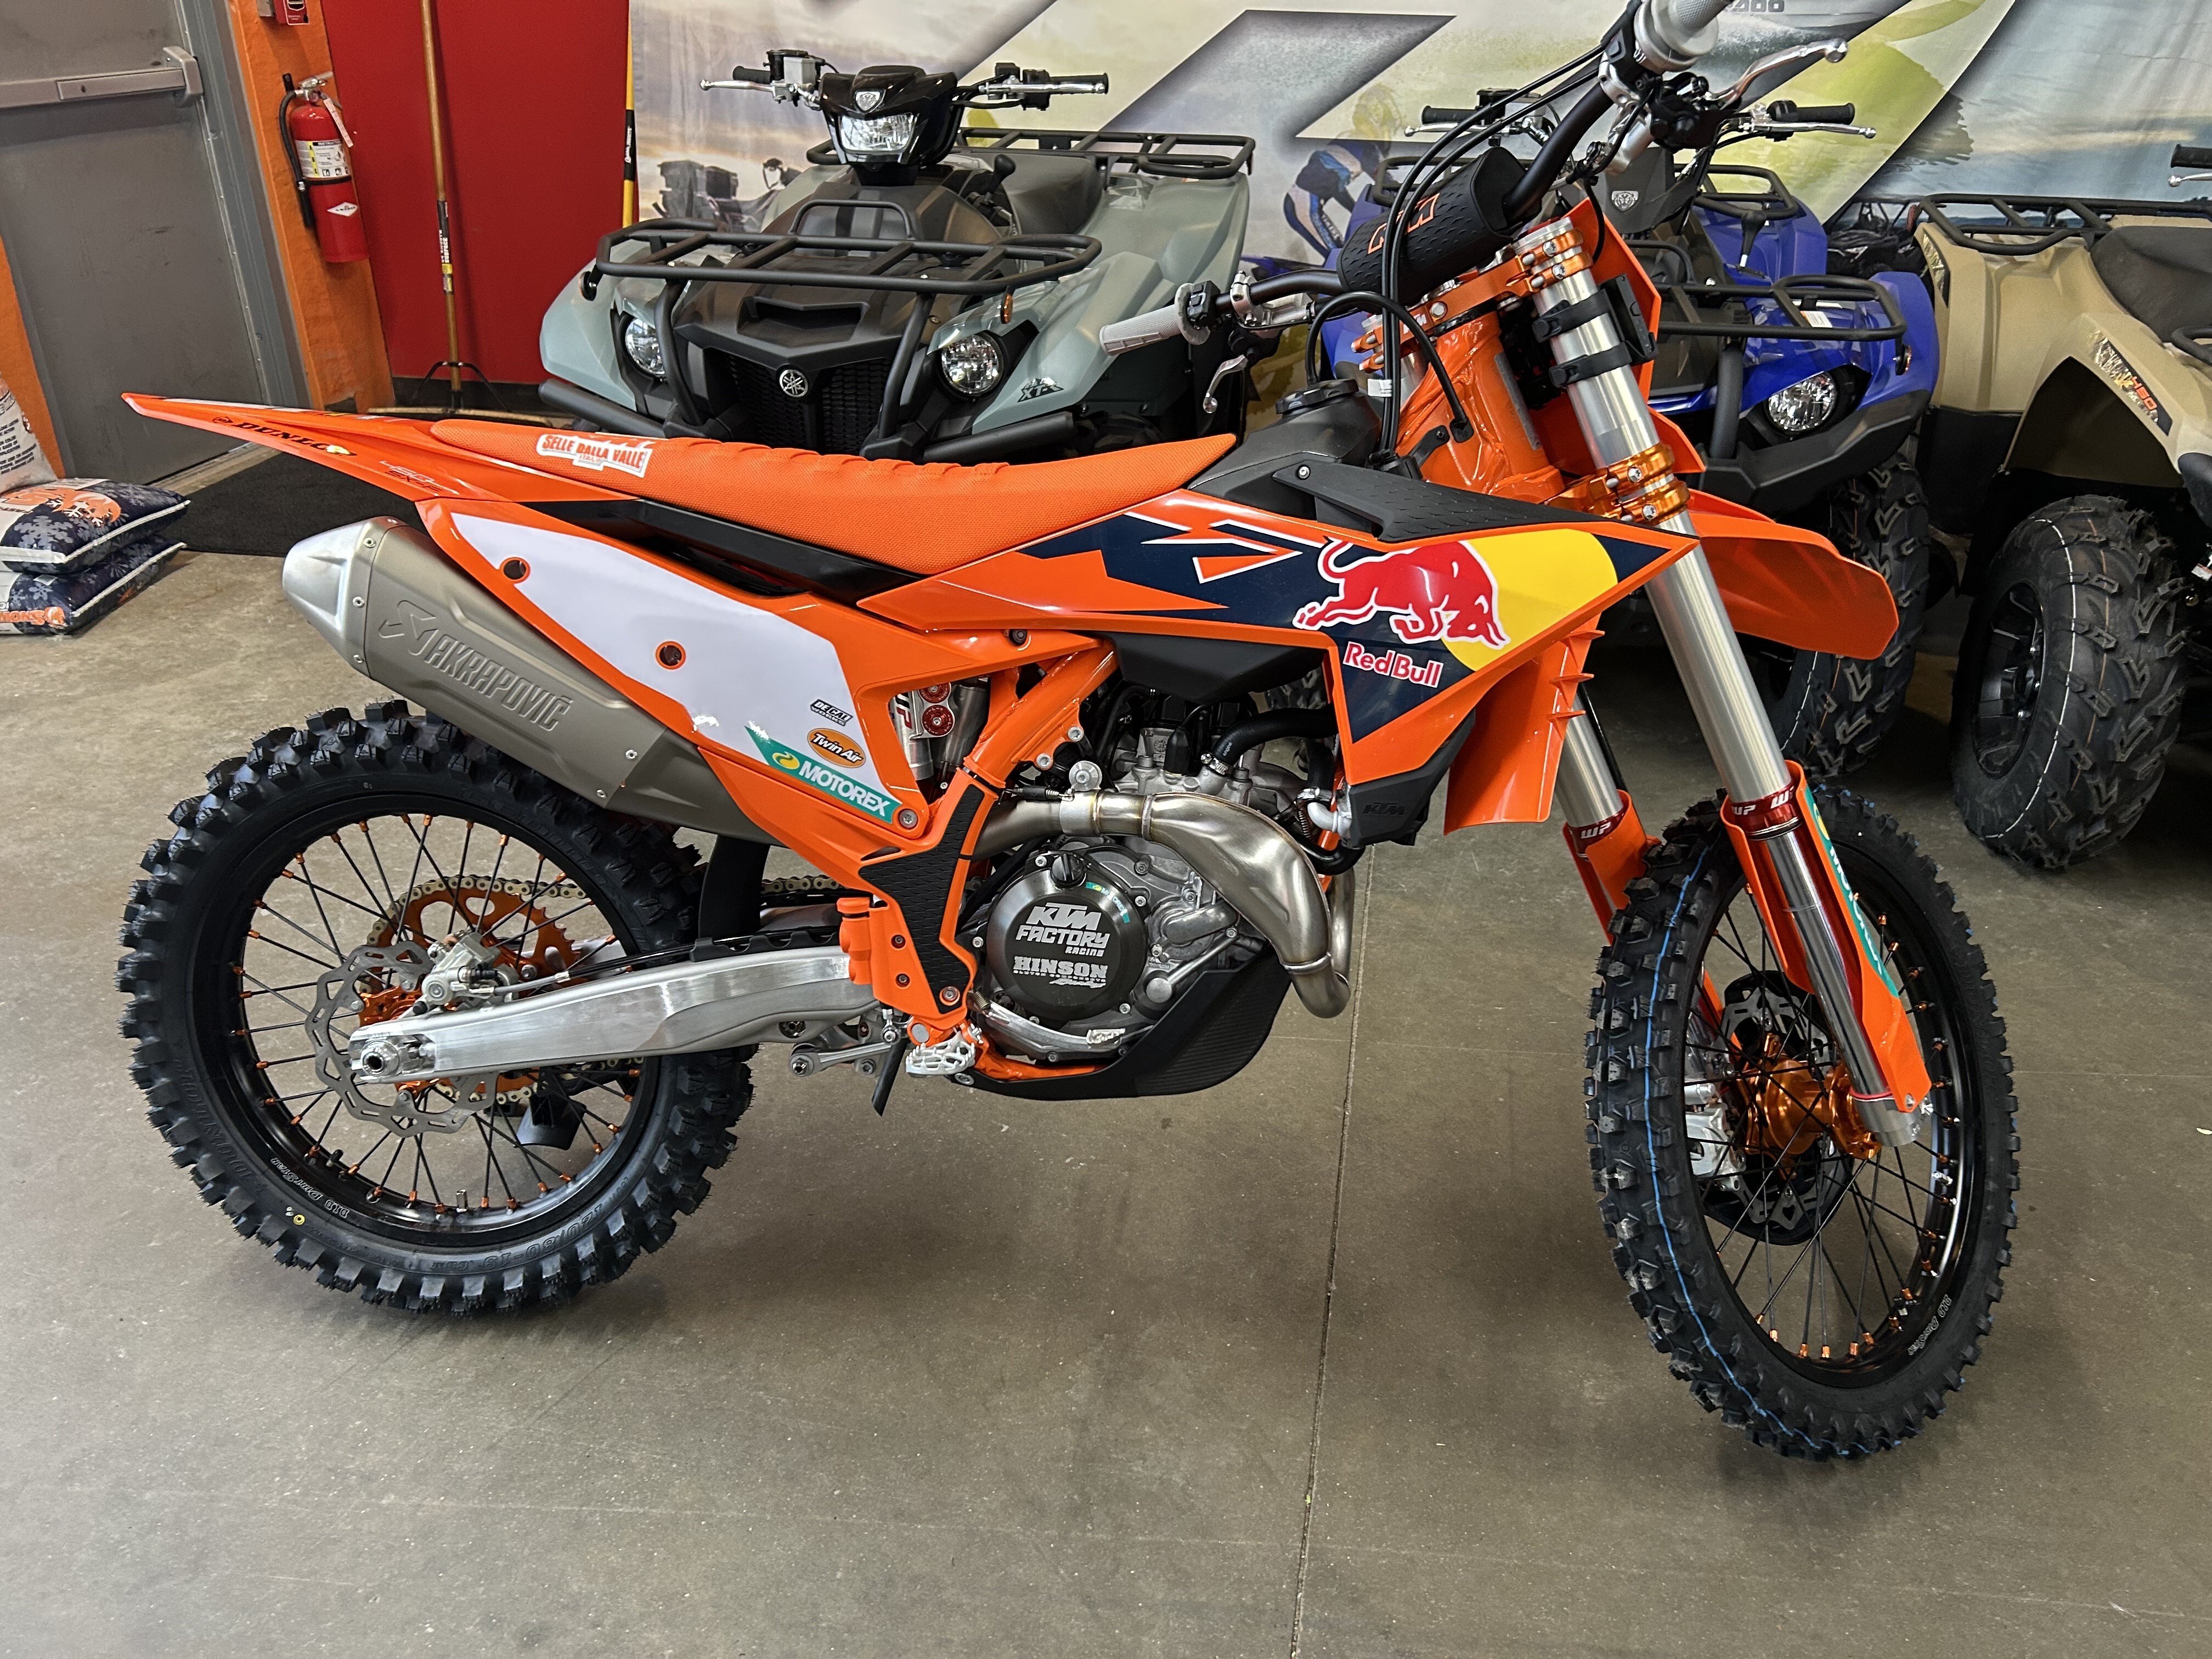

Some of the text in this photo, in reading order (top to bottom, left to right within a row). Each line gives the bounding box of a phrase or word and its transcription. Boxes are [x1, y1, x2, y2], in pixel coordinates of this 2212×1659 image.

[2131, 376, 2157, 410] 450
[233, 422, 358, 456] DUNLO
[542, 435, 646, 469] SELLE DALLA VALLE
[379, 460, 436, 483] 450
[1343, 641, 1444, 688] Red Bull
[812, 732, 862, 763] Twin Air
[798, 760, 891, 817] MOTOREX
[1362, 802, 1406, 817] KTM
[1580, 821, 1611, 839] WP
[1025, 901, 1102, 931] KTM
[1015, 924, 1111, 949] FACTORY
[1064, 946, 1105, 957] RACING
[1013, 956, 1108, 978] HINSON
